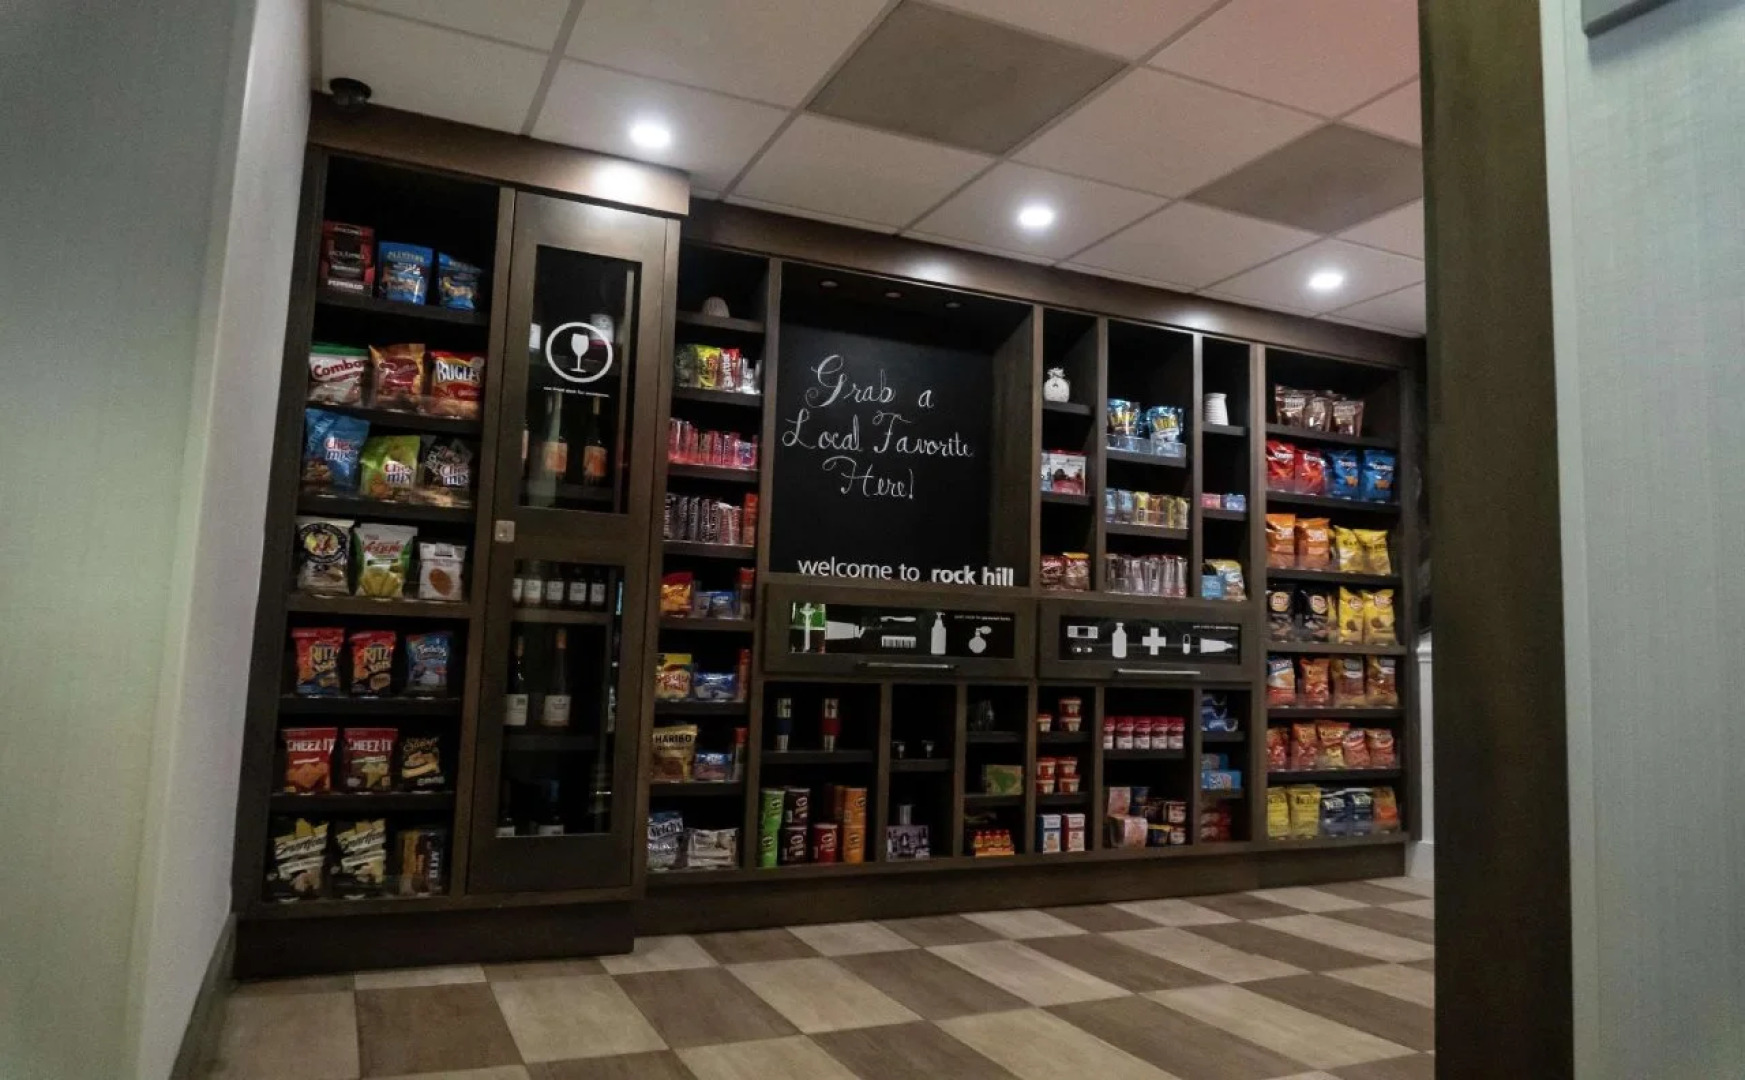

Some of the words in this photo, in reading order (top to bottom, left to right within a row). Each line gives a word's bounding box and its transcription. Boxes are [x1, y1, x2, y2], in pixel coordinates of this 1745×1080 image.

[805, 354, 897, 409] Grab
[917, 389, 935, 409] a
[782, 408, 863, 451] Local
[872, 409, 974, 458] Favorite
[822, 455, 915, 500] Here!
[797, 556, 893, 581] welcome
[899, 562, 921, 582] to
[930, 564, 977, 585] rock
[981, 566, 1014, 587] hill
[310, 646, 339, 663] RITZ
[363, 646, 390, 664] RITZ
[654, 733, 692, 744] HARIBO
